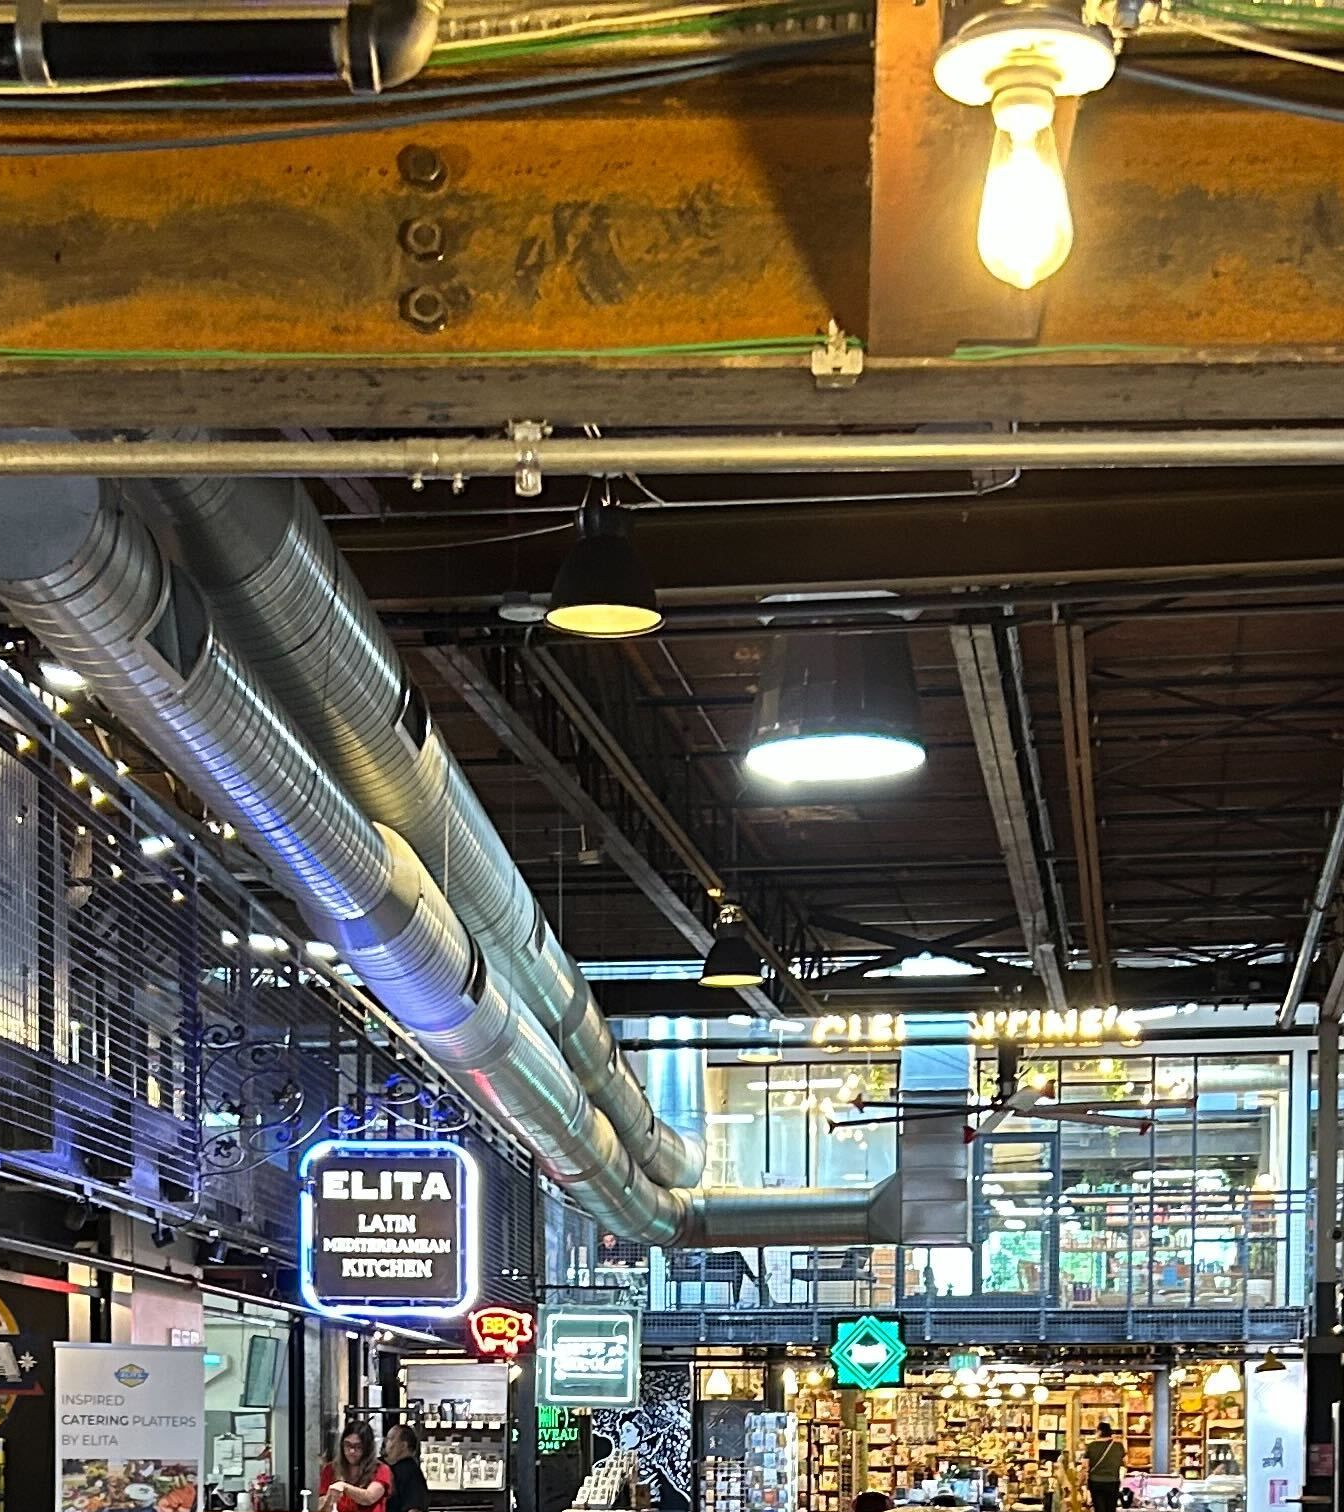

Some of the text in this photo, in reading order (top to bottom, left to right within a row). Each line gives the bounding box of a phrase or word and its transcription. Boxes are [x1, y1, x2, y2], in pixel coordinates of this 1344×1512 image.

[322, 1170, 452, 1200] ELITA
[358, 1213, 417, 1233] LATIN
[322, 1237, 452, 1254] MEDITERRANEAN
[341, 1258, 433, 1278] KITCHEN
[480, 1316, 521, 1338] BBQ
[60, 1394, 125, 1407] INSPIRED
[61, 1414, 197, 1428] CATERING PLATTERS
[61, 1434, 119, 1447] BY ELITA
